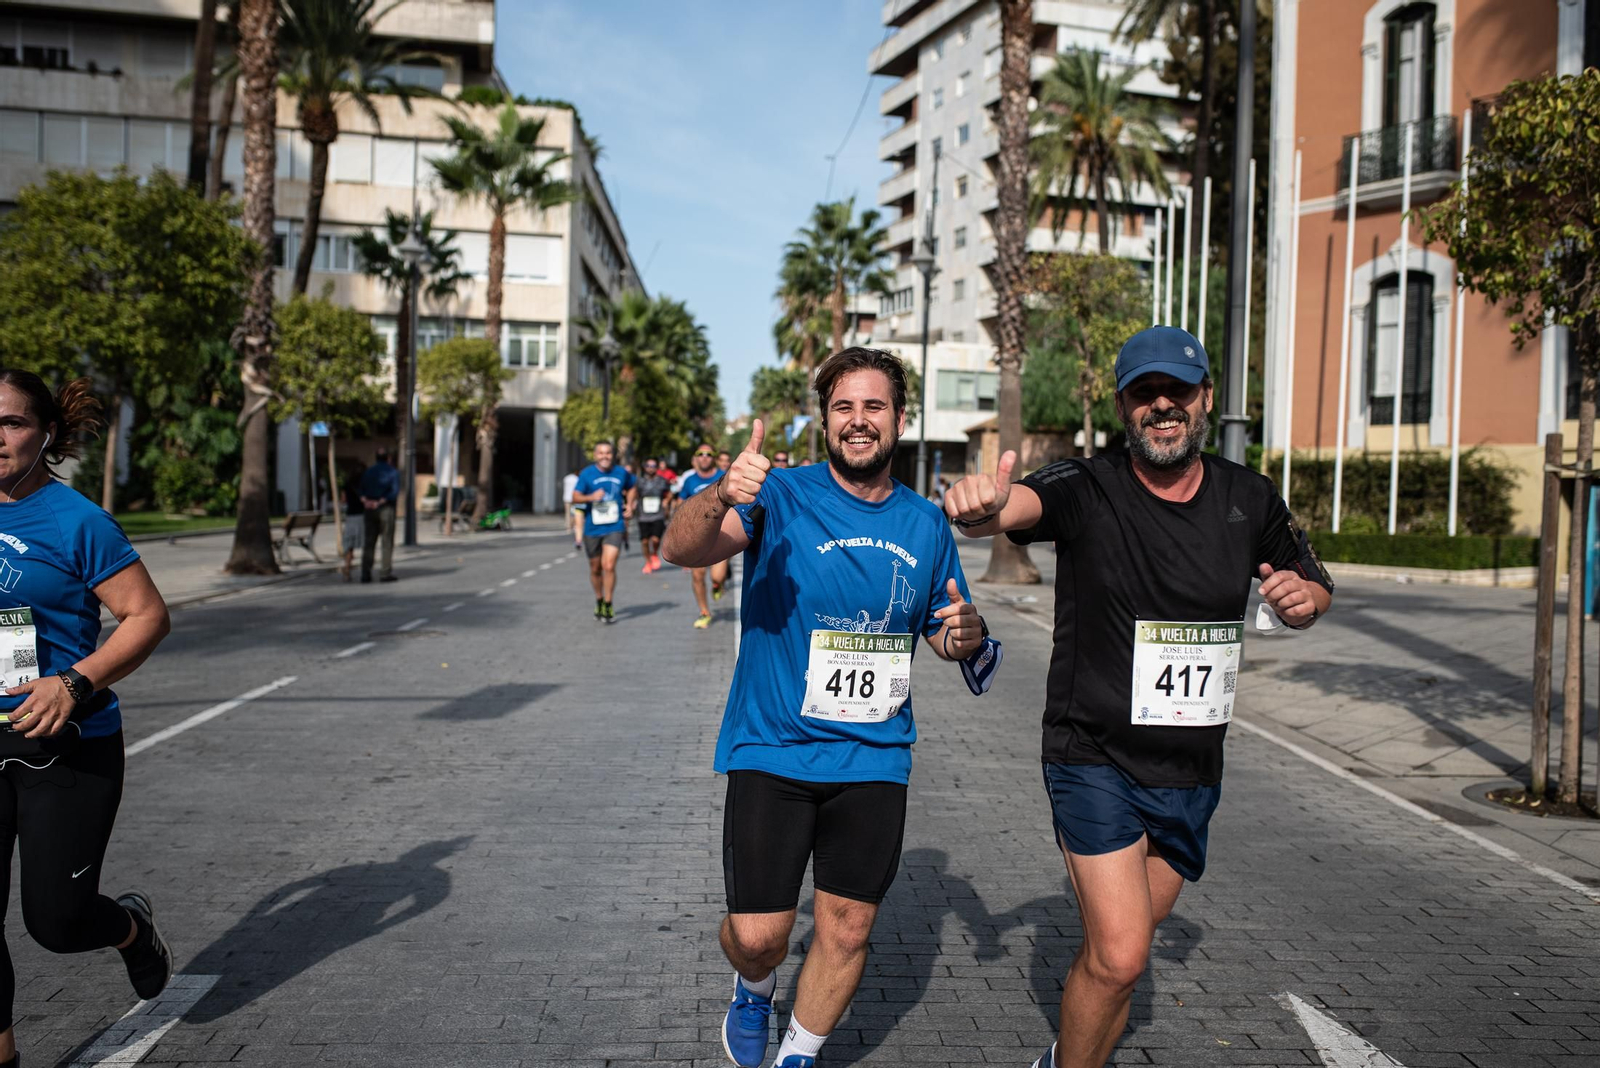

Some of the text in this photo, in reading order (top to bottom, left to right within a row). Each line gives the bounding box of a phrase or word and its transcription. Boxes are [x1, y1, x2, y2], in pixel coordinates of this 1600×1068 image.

[835, 537, 874, 548] VUELTA
[875, 539, 884, 549] A
[884, 541, 918, 569] HUELVA
[1144, 628, 1237, 642] 34 VUELTA A HUELVA
[819, 636, 905, 651] 34 VUELTA A HUELVA
[1162, 646, 1203, 655] JOSE LUIS
[833, 652, 851, 660] JOSE
[825, 668, 875, 698] 418
[1155, 664, 1213, 697] 417
